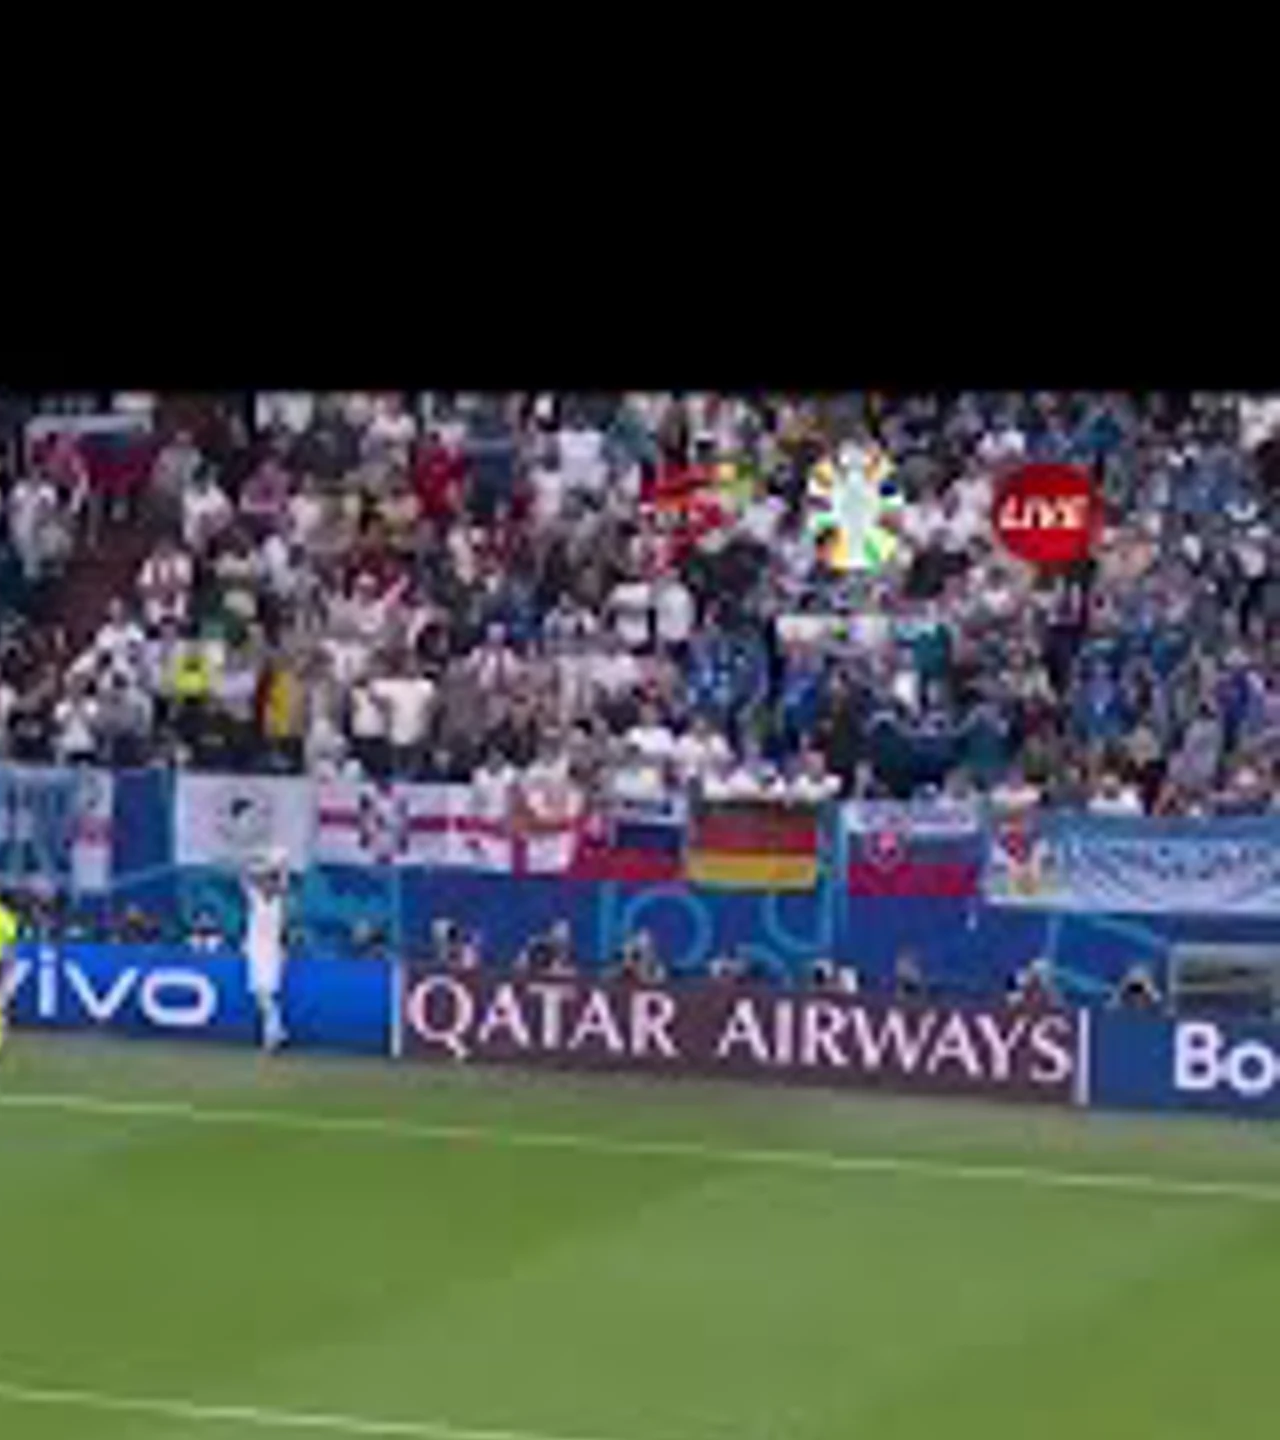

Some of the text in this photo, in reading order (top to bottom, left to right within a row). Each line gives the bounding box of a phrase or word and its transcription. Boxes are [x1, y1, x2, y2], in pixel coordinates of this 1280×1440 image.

[2, 948, 217, 1027] vivo
[406, 975, 1072, 1083] QATAR AIRWAYS
